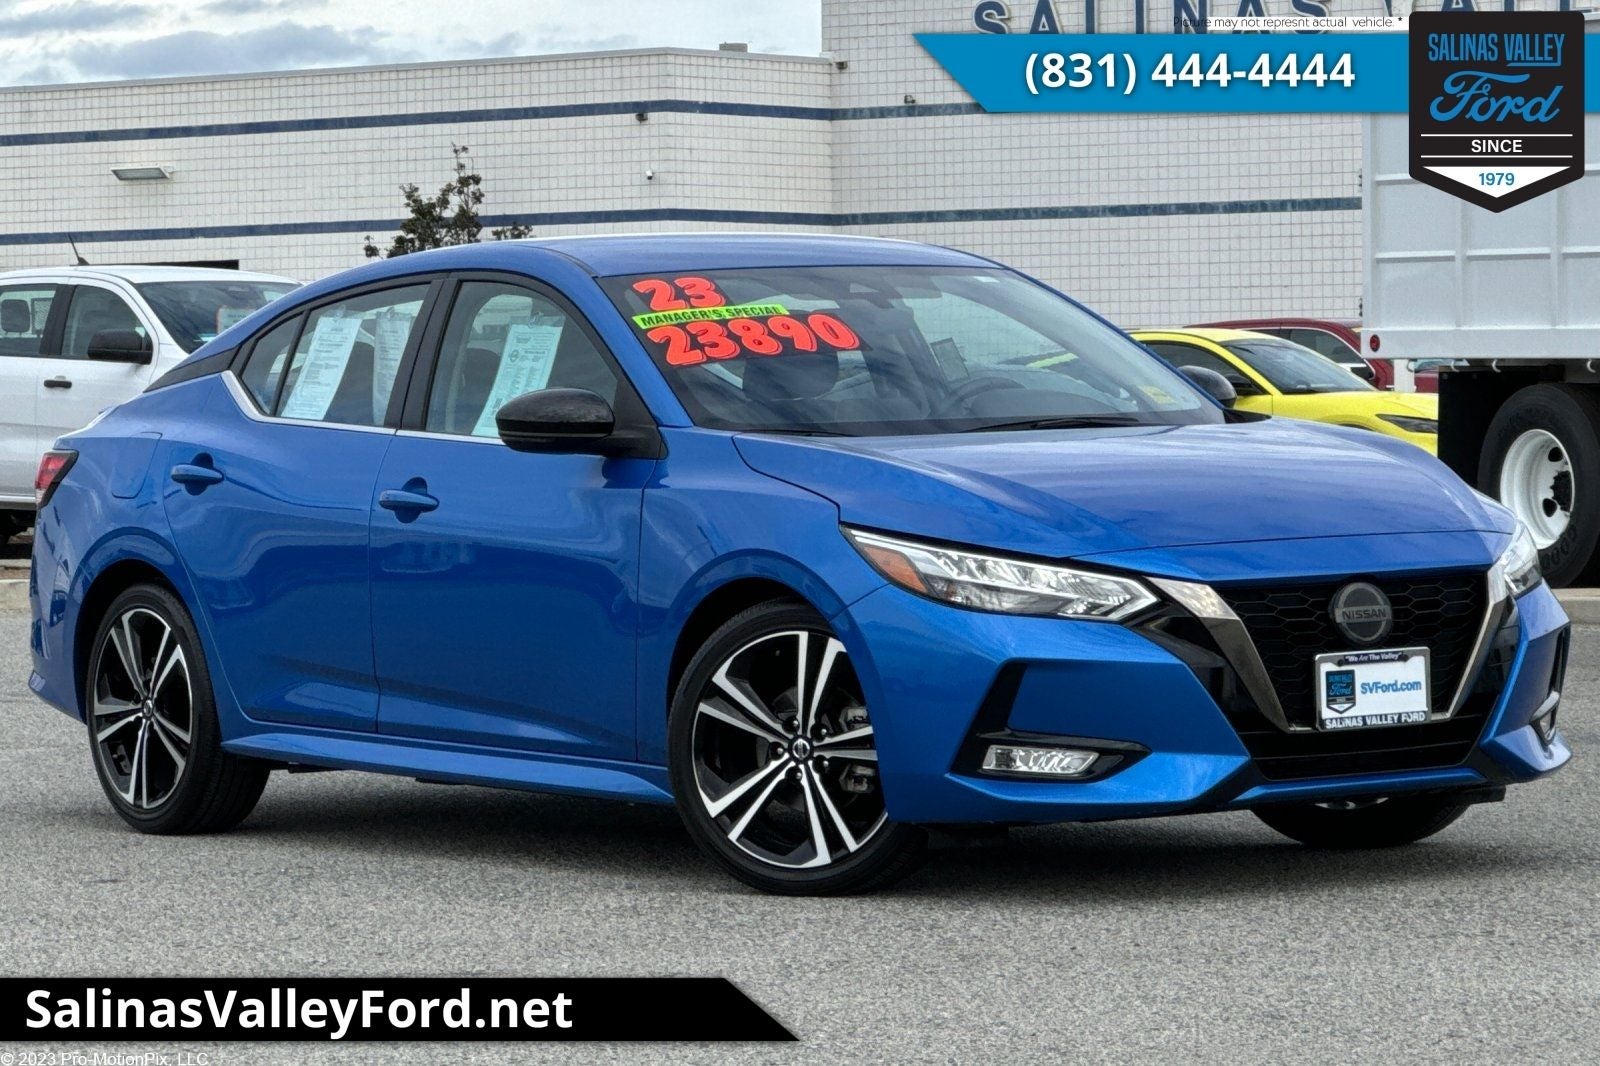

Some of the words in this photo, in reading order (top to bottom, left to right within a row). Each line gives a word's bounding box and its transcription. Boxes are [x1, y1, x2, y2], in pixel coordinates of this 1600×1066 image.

[632, 276, 726, 311] 23
[640, 309, 723, 327] MANAGER'S
[725, 306, 781, 320] SPECIAL
[647, 313, 860, 366] 23890
[1342, 607, 1387, 620] NISSAN
[1360, 679, 1422, 694] SVFord.com
[1325, 717, 1363, 729] SALINAS
[1366, 714, 1399, 726] VALLEY
[1401, 711, 1426, 722] FORD
